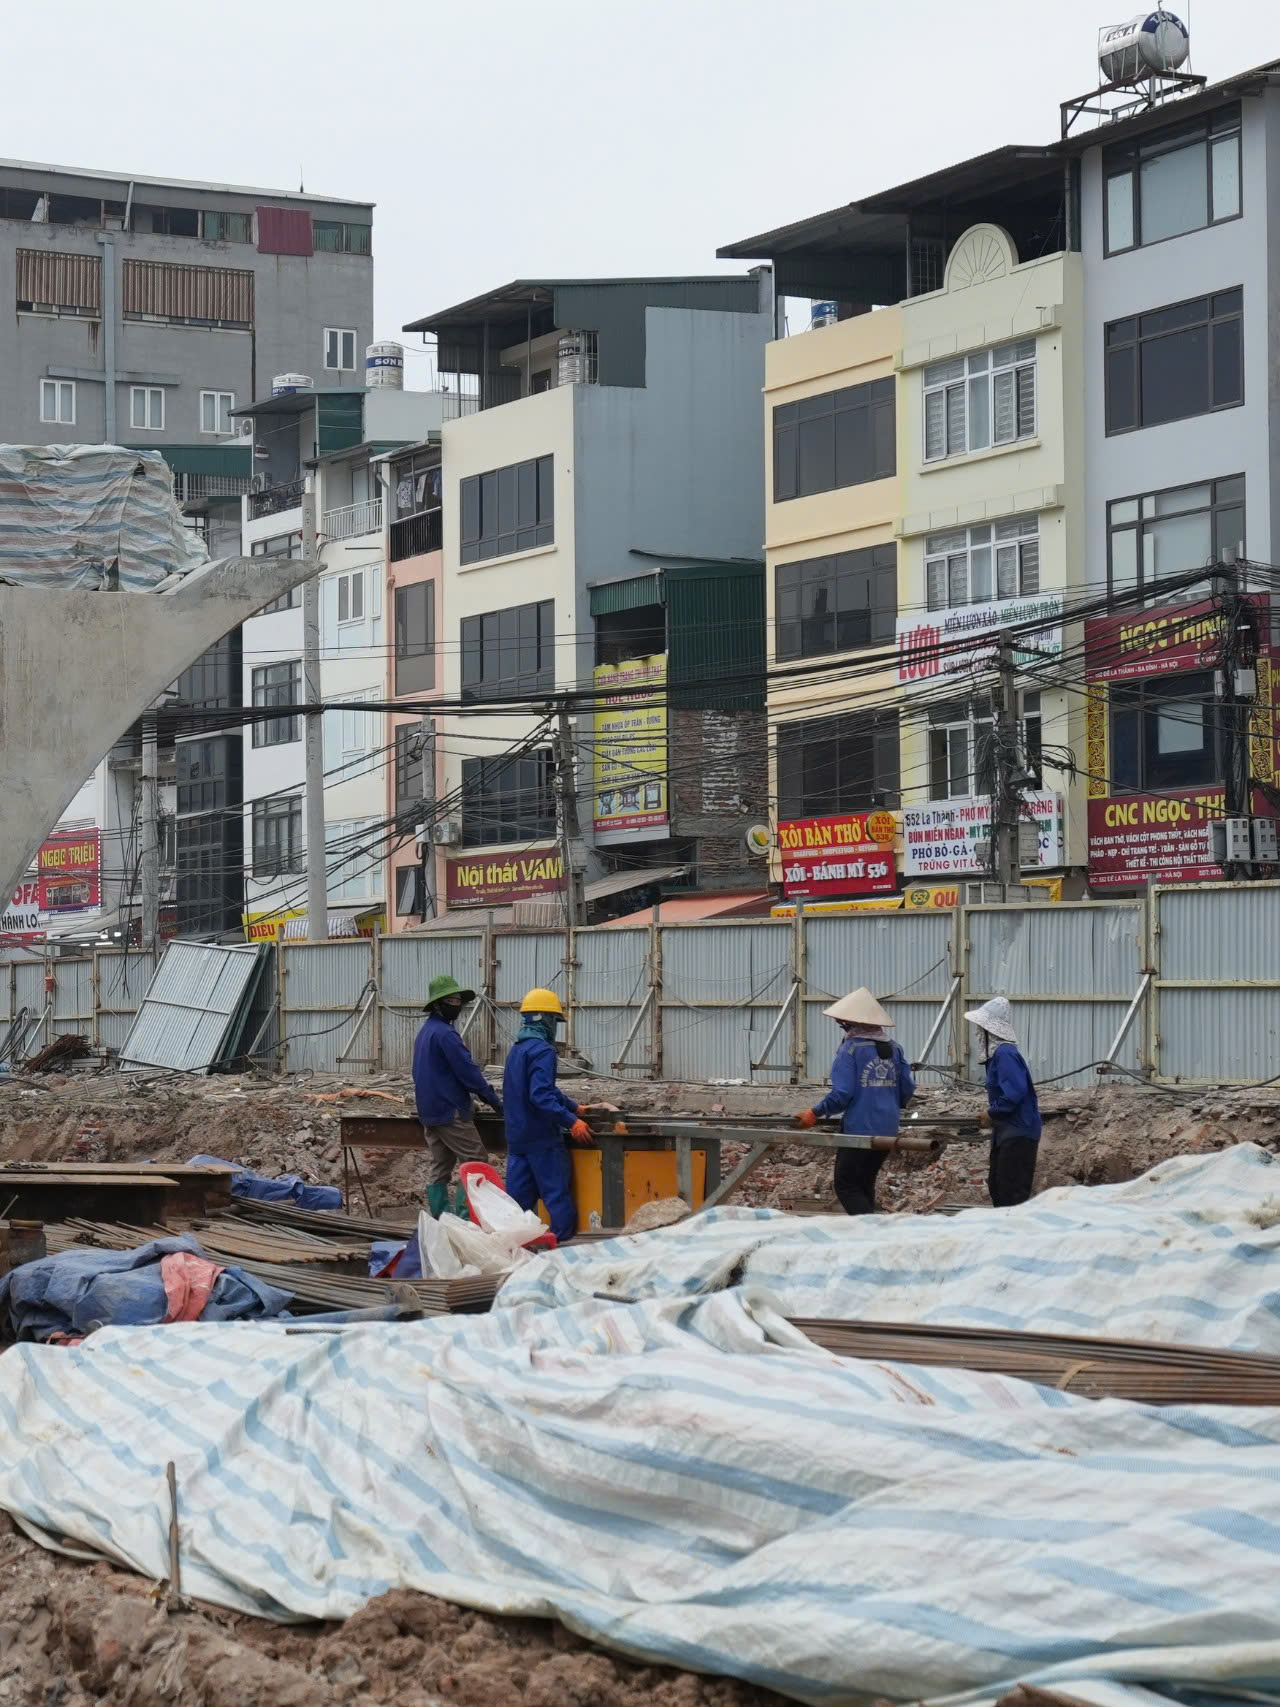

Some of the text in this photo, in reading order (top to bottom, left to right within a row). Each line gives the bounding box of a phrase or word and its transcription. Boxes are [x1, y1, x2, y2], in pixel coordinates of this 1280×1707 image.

[1105, 802, 1139, 827] CNC
[1143, 797, 1191, 827] NGỌC
[780, 824, 803, 848] XÔI
[805, 821, 832, 846] BÀN
[834, 818, 862, 844] THỜ
[944, 827, 965, 841] NGAN
[41, 841, 95, 869] NGỌC TRIỆU
[457, 863, 483, 889] Nội
[486, 859, 519, 884] thất
[785, 862, 807, 883] XÔI
[812, 861, 846, 881] BÁNH
[867, 862, 888, 878] 536
[11, 883, 39, 906] OFA
[0, 912, 26, 930] HÀNH
